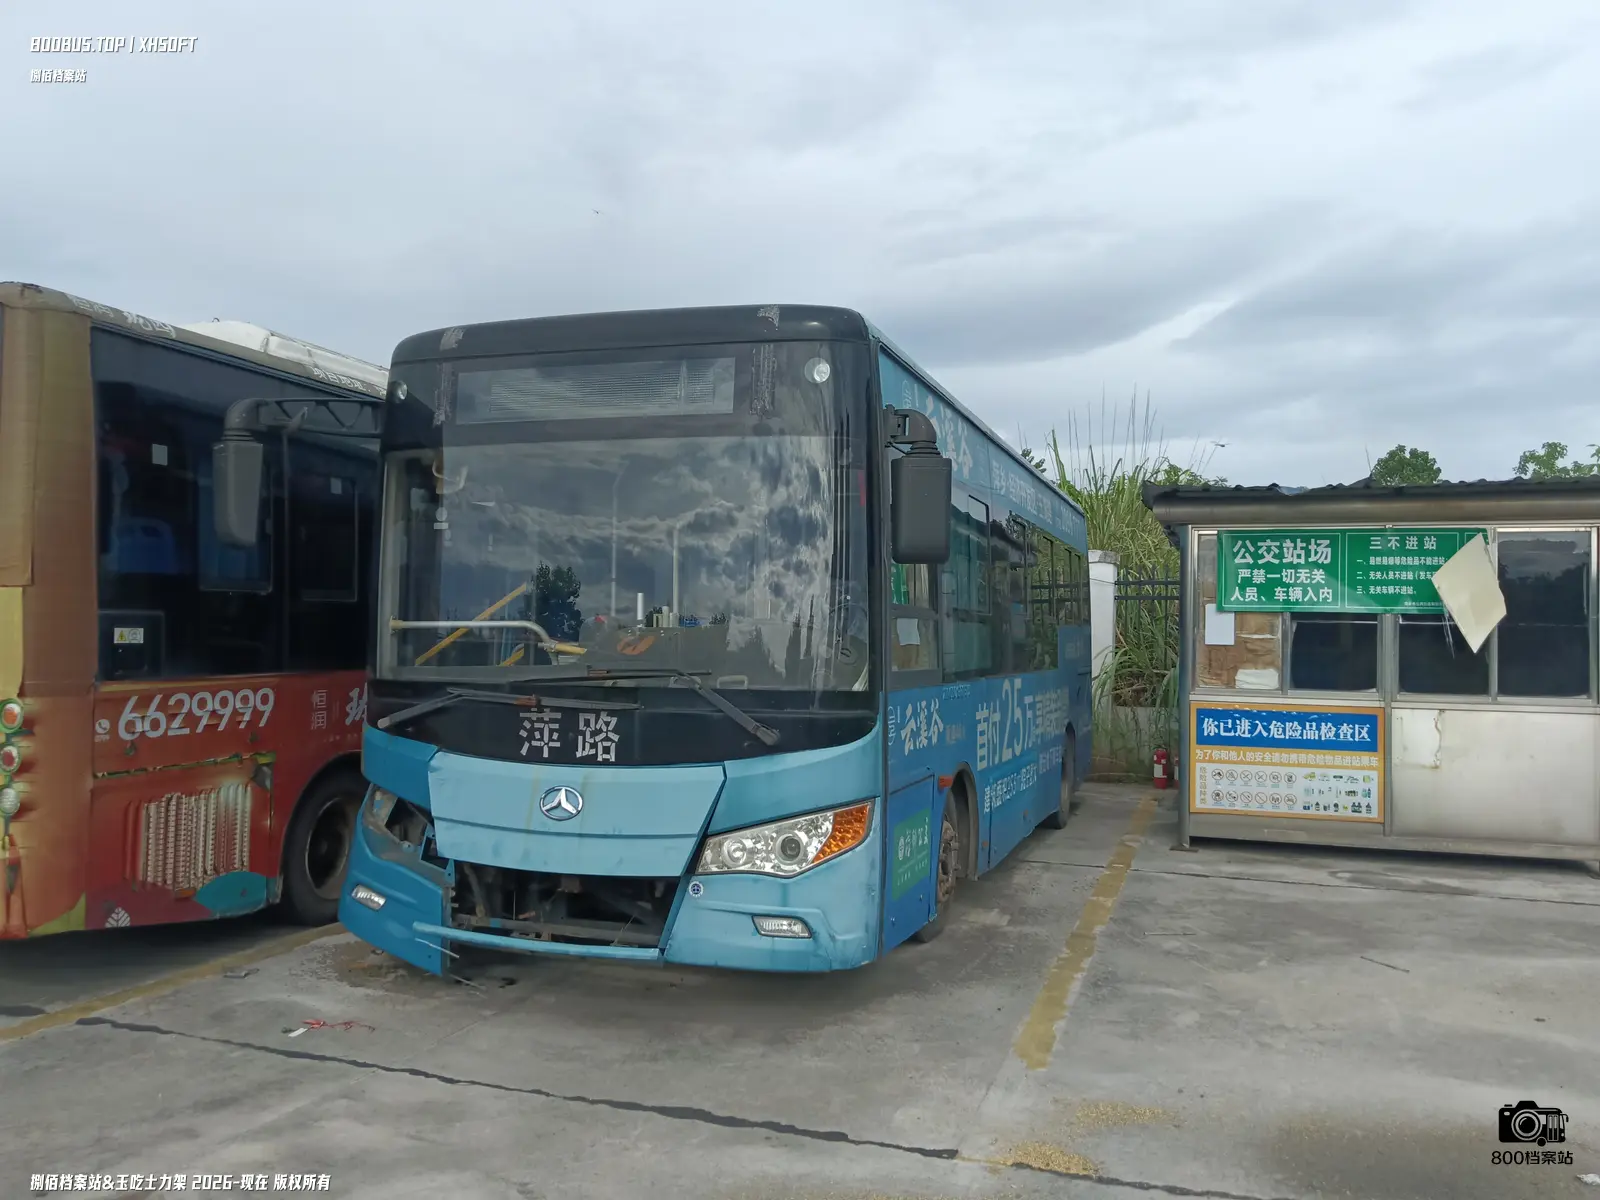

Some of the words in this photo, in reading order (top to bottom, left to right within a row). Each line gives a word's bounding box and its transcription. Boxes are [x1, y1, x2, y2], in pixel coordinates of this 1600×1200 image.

[1232, 538, 1332, 565] 公交站场
[1369, 535, 1437, 550] 三不进站
[1237, 568, 1326, 584] 严禁一切无关
[1230, 586, 1333, 602] 人员、车辆入内
[118, 687, 275, 741] 6629999
[1202, 717, 1372, 742] 你已进入危险品检查区
